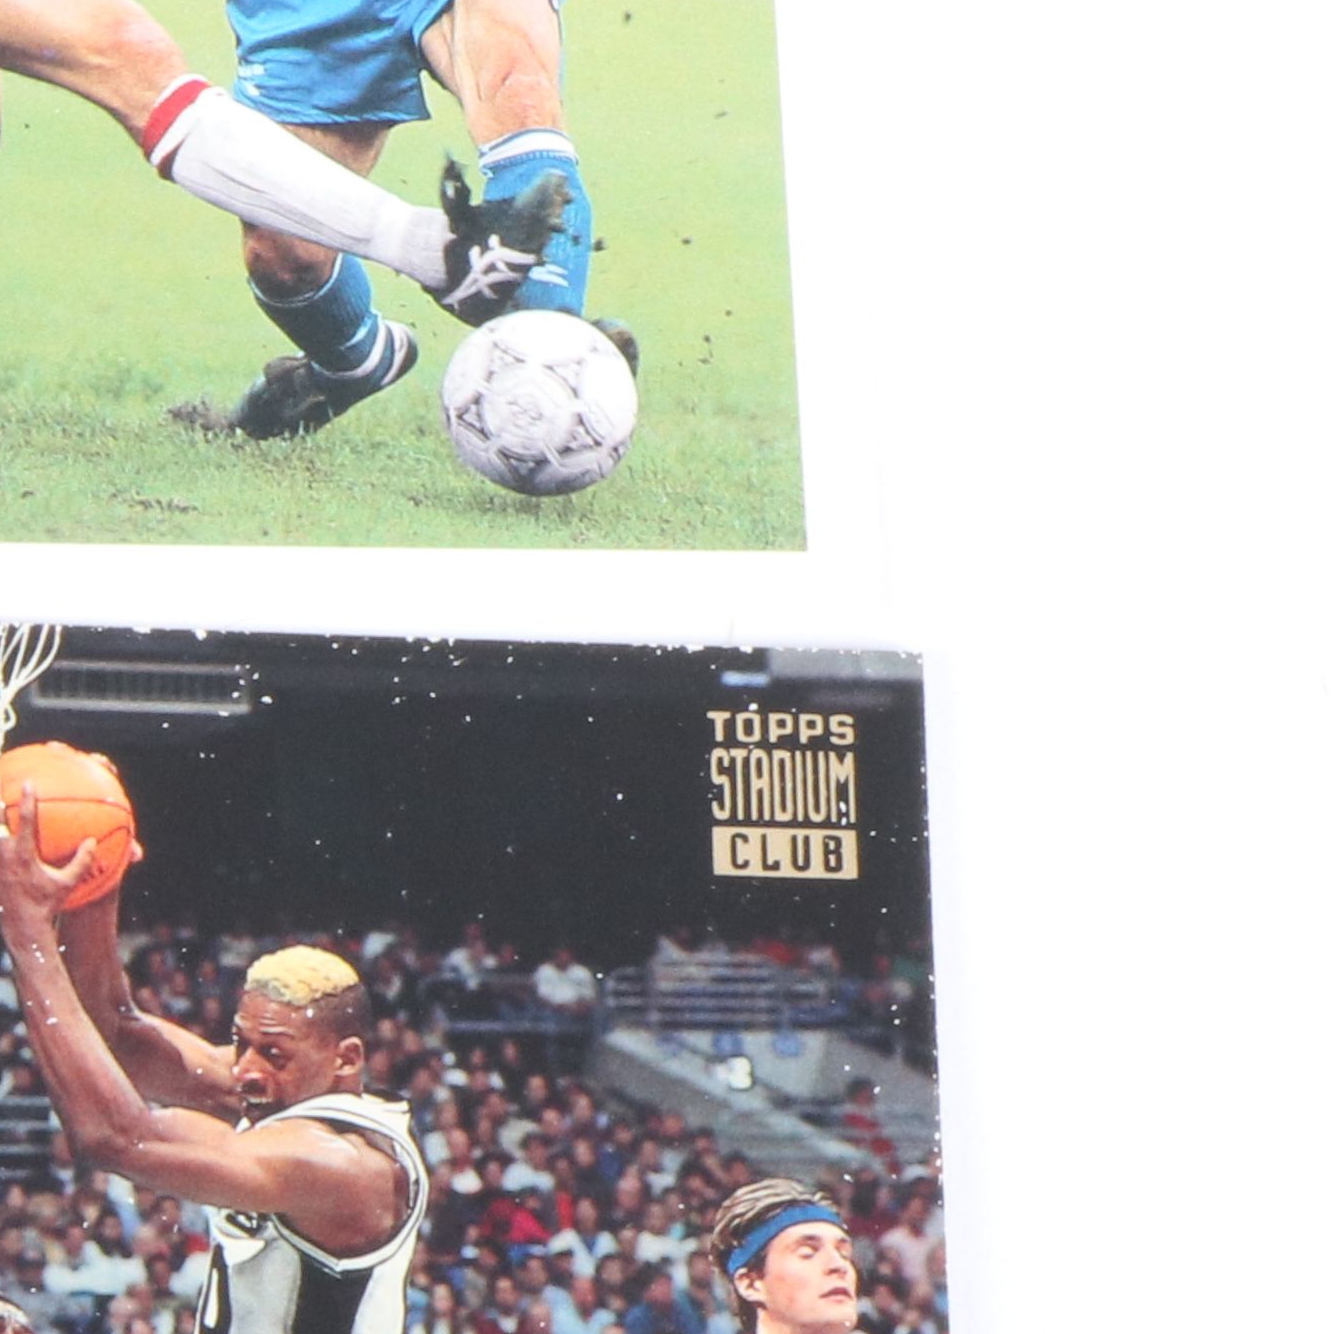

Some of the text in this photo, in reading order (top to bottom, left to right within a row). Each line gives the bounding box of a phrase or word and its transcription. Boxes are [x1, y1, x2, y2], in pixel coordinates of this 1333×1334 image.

[706, 710, 856, 746] TOPPS
[710, 746, 857, 824] STADIUM
[729, 832, 843, 874] CLUB
